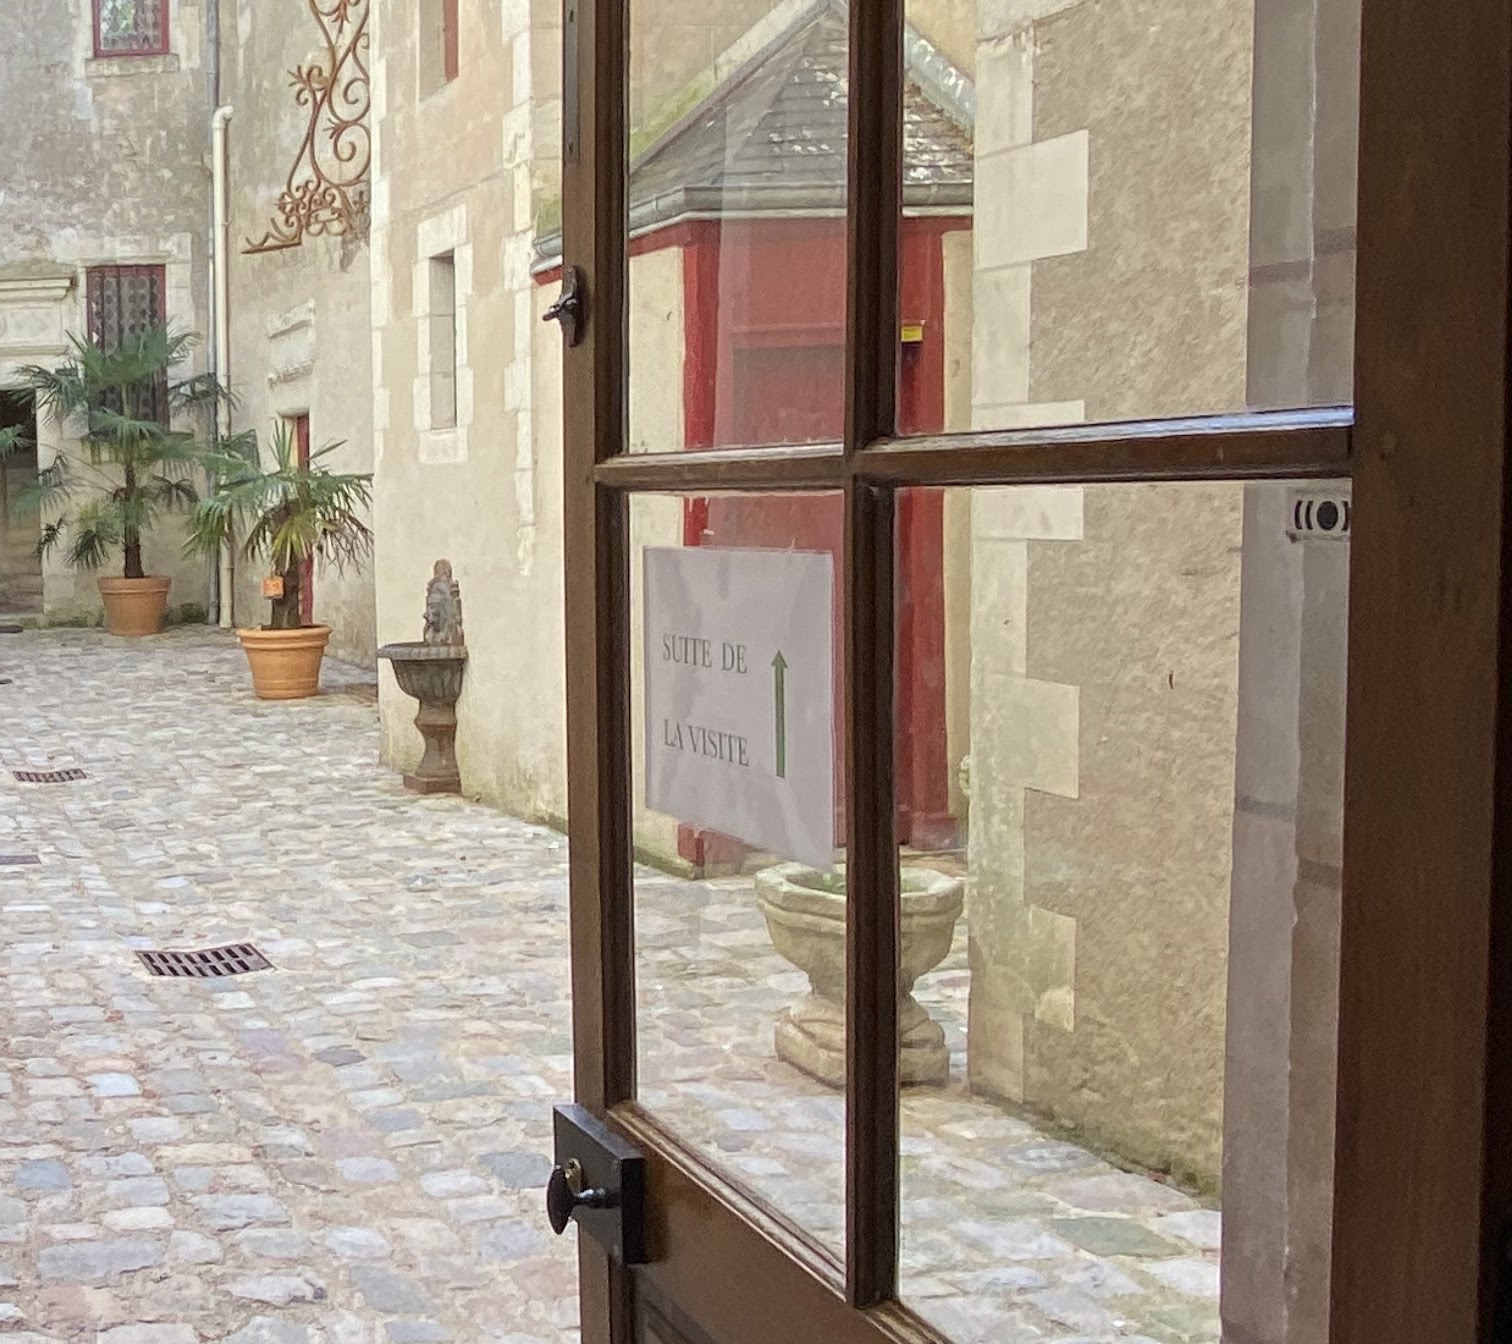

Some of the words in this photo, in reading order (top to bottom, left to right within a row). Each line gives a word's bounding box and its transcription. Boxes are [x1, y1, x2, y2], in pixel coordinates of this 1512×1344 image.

[662, 633, 712, 668] SUITE
[721, 642, 748, 674] DE
[663, 718, 684, 750] LA
[687, 725, 750, 767] VISITE
